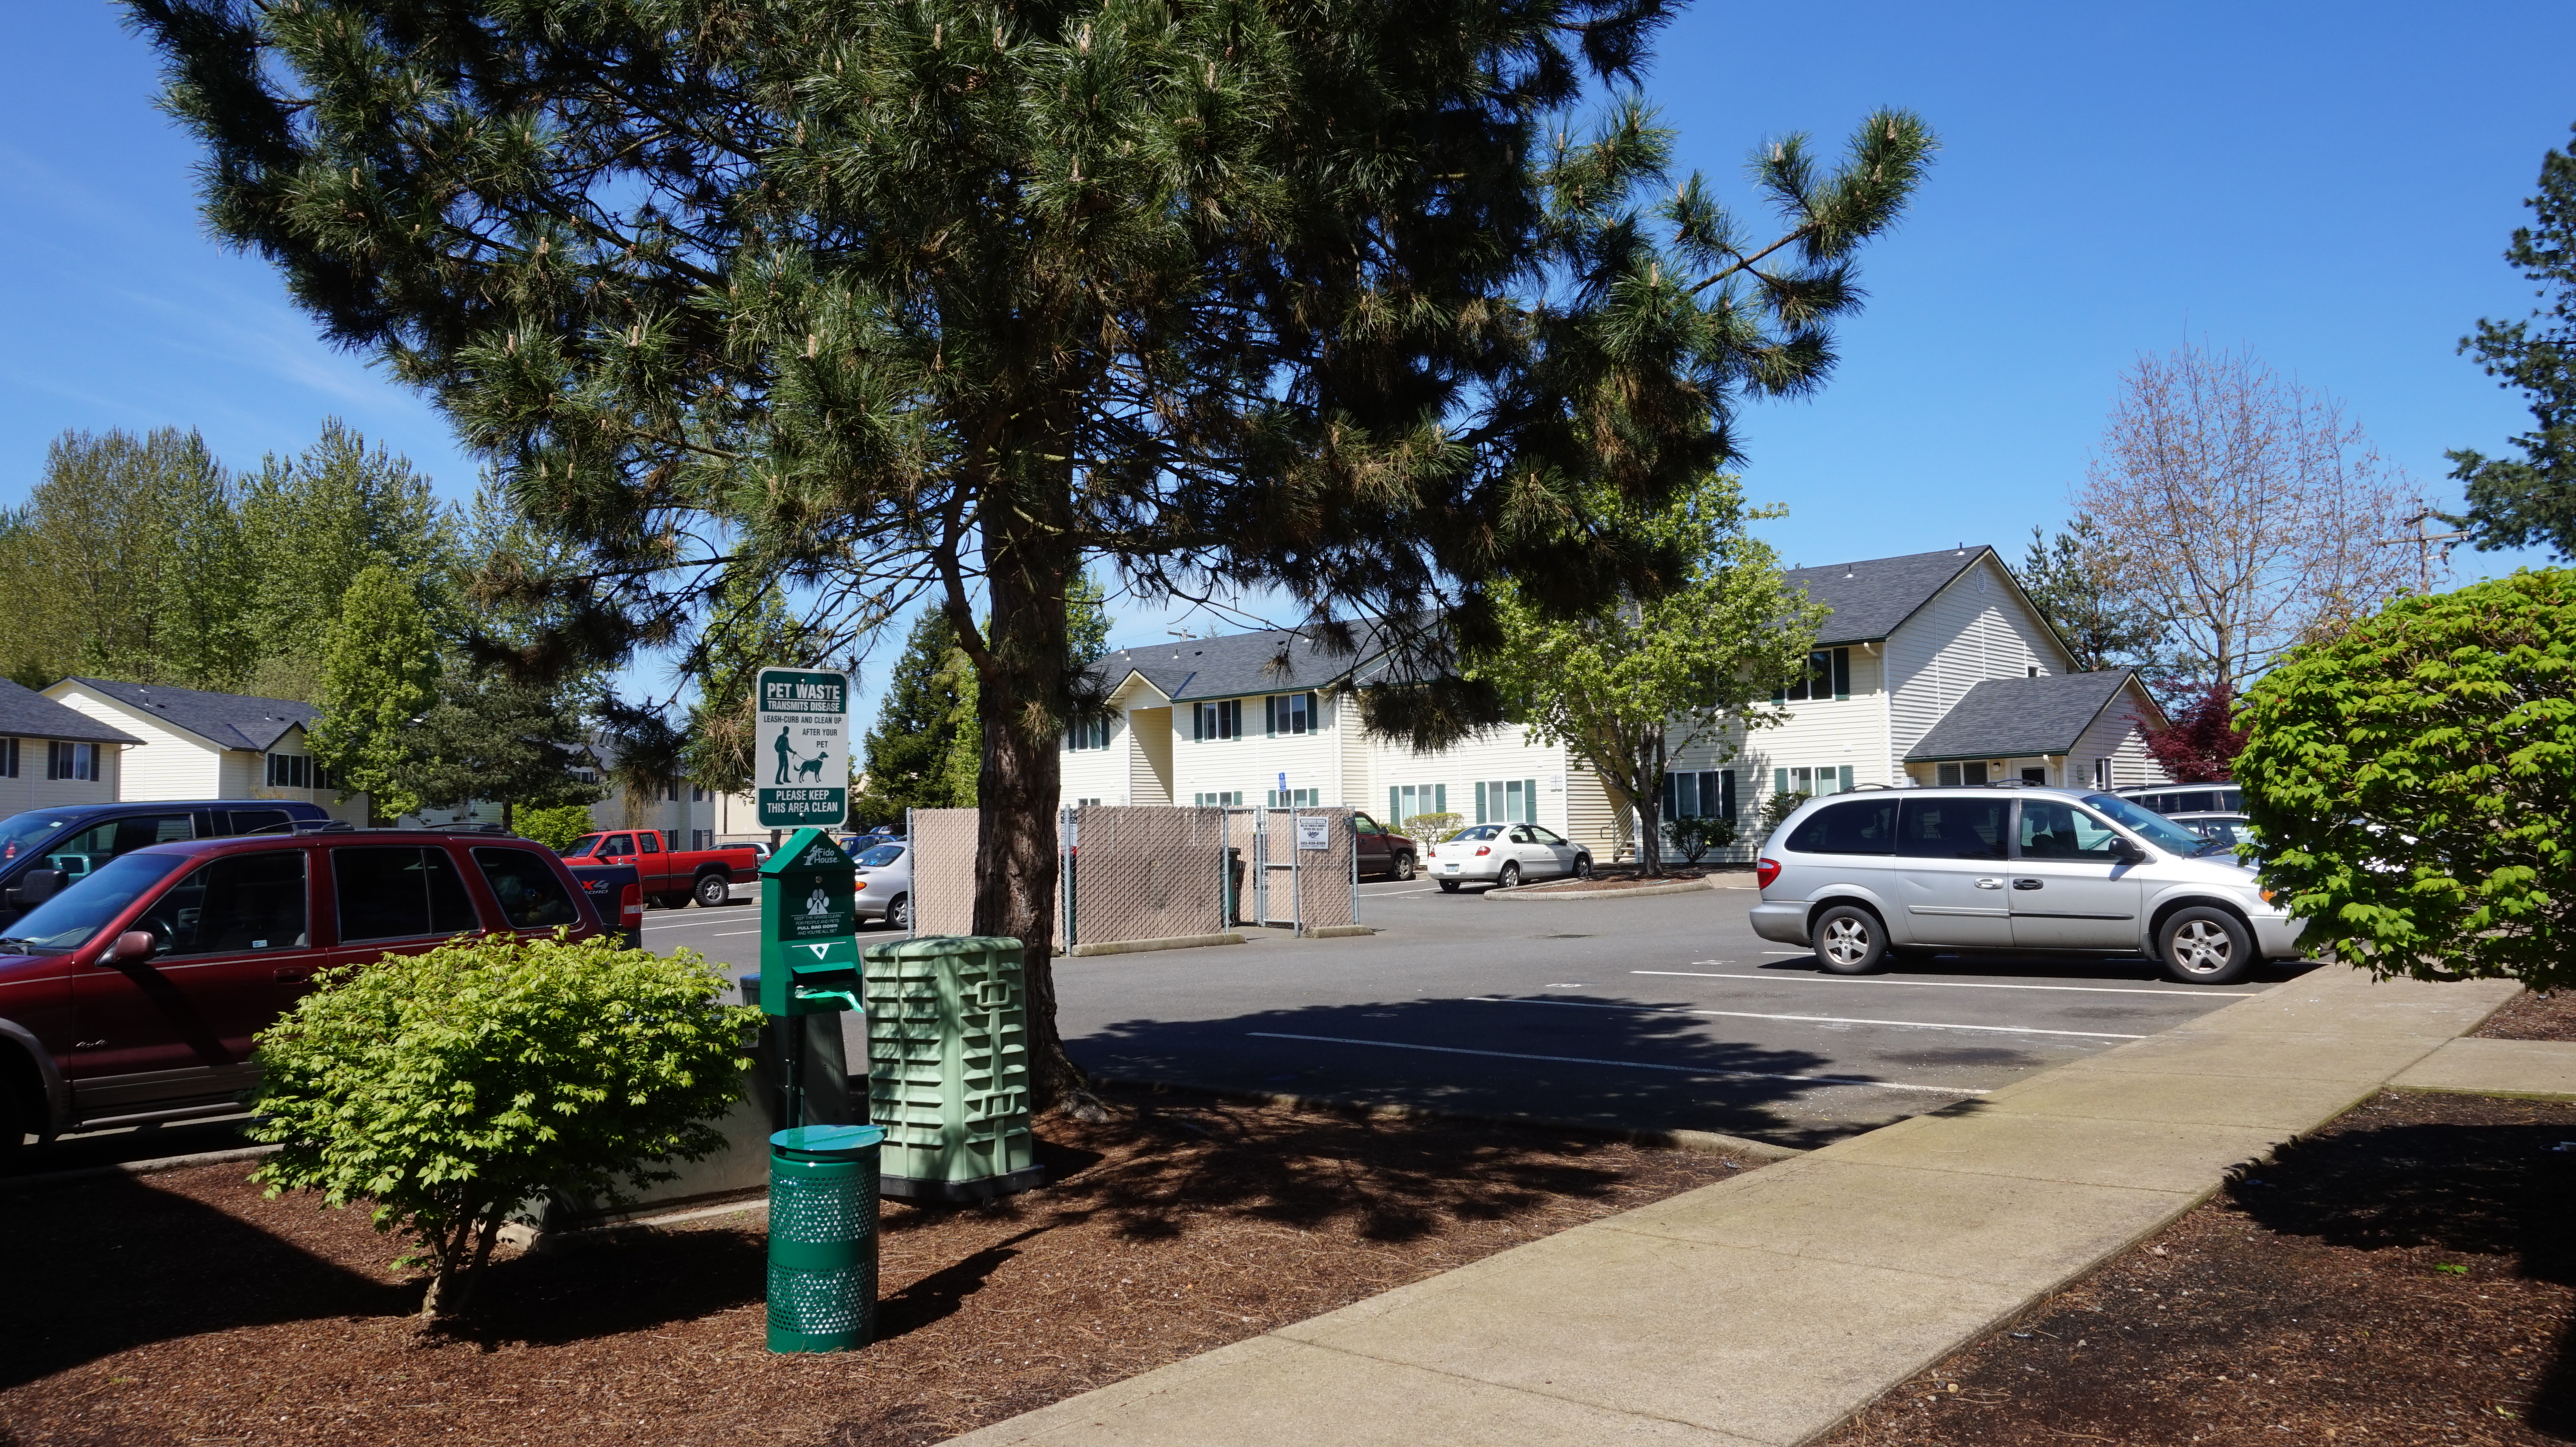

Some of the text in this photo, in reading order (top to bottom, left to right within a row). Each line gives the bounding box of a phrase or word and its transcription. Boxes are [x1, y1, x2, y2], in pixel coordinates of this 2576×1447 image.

[767, 682, 840, 700] PET WASTE
[767, 700, 839, 712] TRANSMITS DISEASE
[763, 715, 799, 723] LEASH-CURB
[776, 790, 829, 800] PLEASE KEEP
[767, 801, 838, 813] THIS AREA CLEAN
[818, 848, 835, 856] Fido
[814, 855, 838, 863] House
[582, 880, 610, 890] X4
